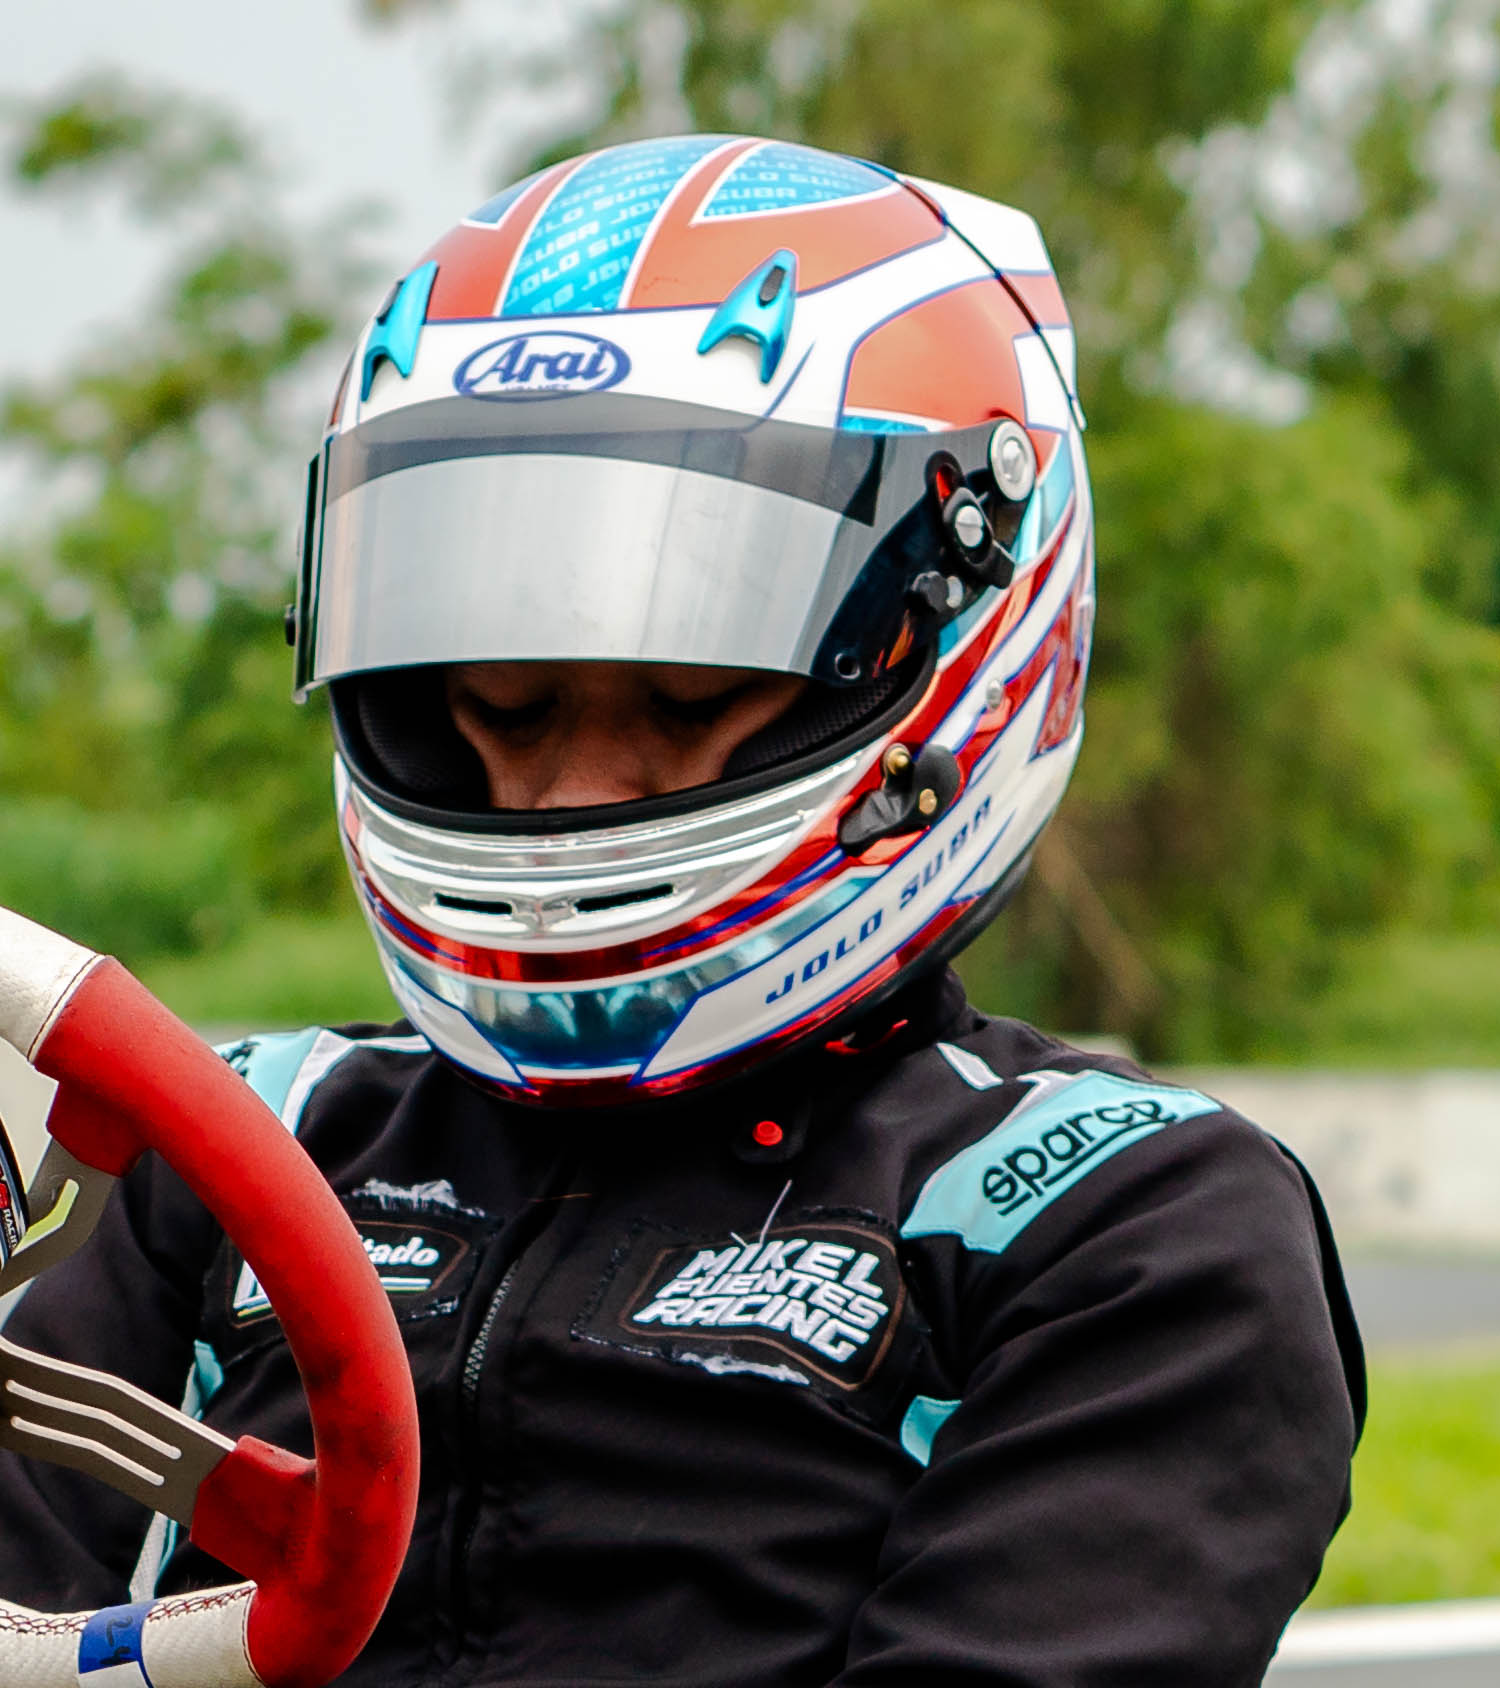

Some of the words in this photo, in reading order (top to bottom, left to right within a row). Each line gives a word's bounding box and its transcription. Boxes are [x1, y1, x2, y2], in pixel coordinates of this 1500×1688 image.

[465, 337, 608, 386] Arai
[765, 908, 884, 1005] JOLO
[899, 794, 992, 912] SUBA
[982, 1100, 1179, 1217] sparco
[654, 1268, 890, 1332] FUENTES
[676, 1238, 884, 1300] MIKEL
[632, 1294, 871, 1364] RACING
